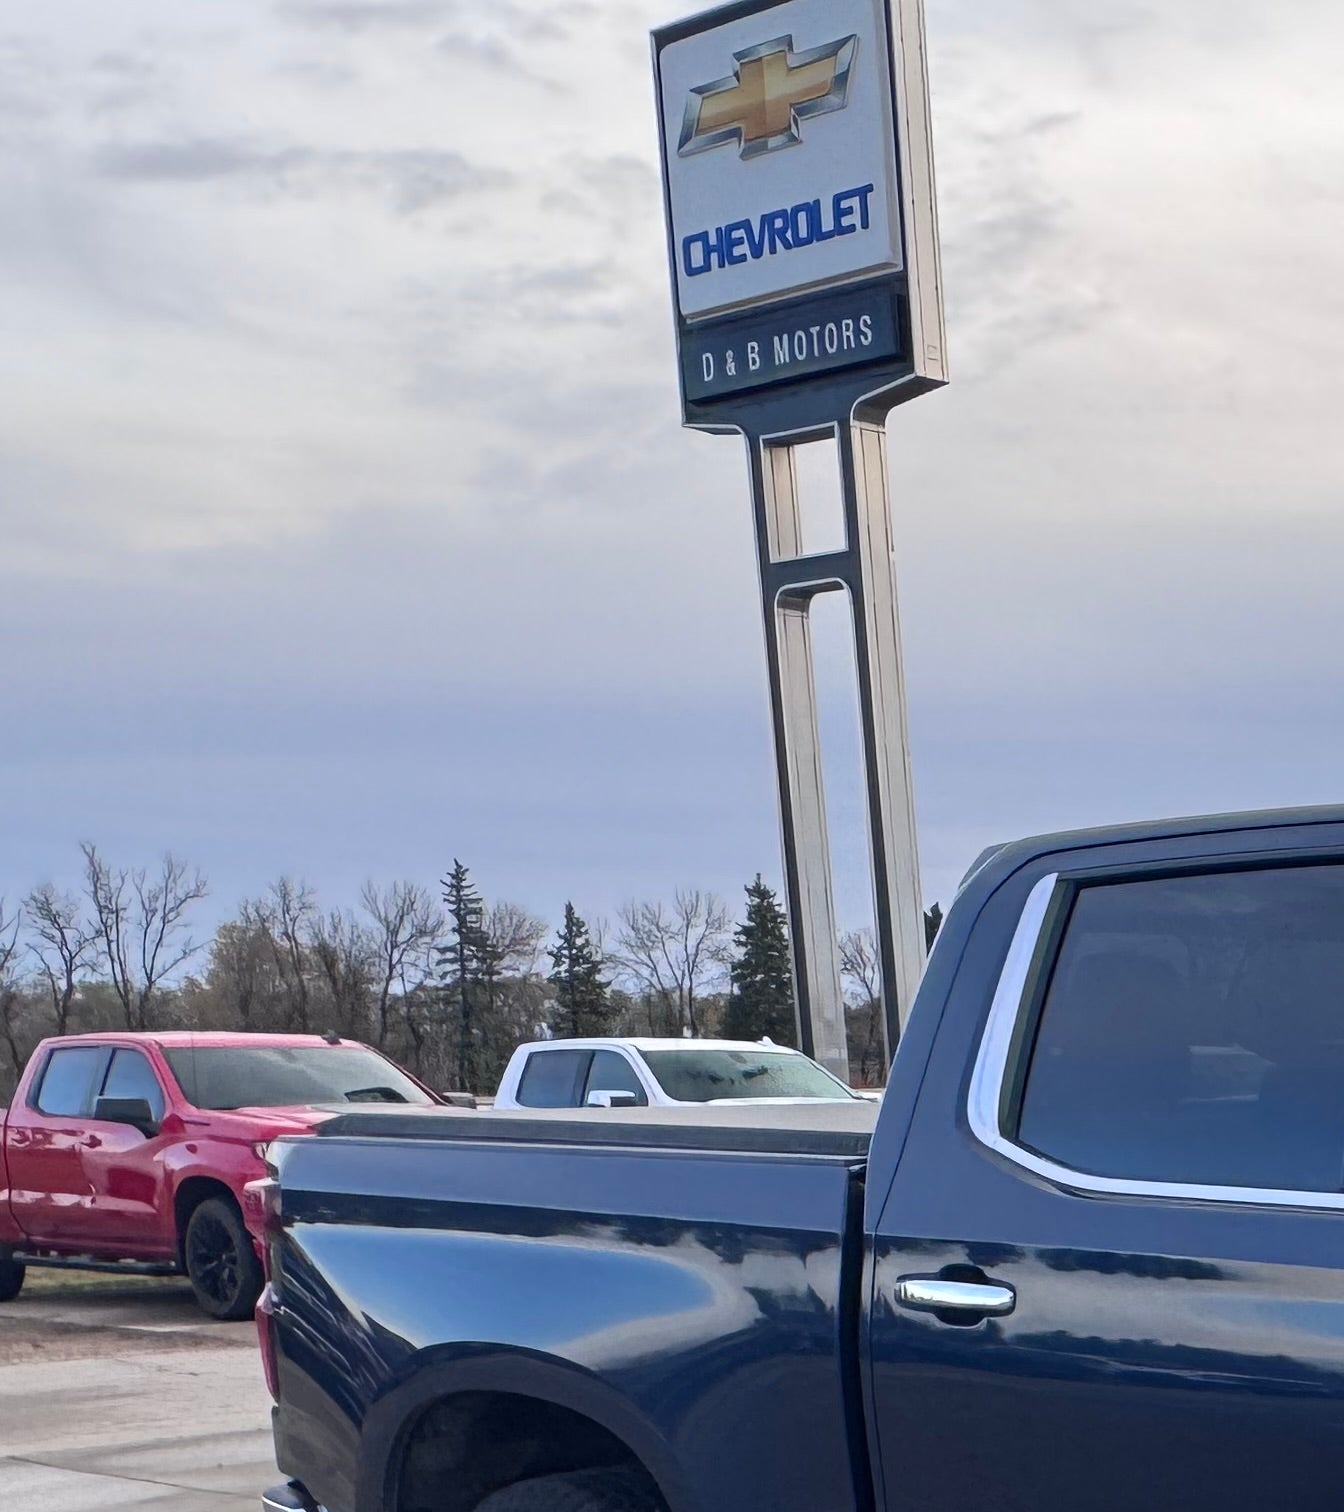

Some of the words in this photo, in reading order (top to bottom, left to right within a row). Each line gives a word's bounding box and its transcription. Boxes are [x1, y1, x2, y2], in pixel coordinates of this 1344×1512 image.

[682, 183, 873, 277] CHEVROLET
[702, 352, 714, 382] D
[726, 351, 736, 375] &
[747, 341, 760, 371] B
[774, 315, 873, 365] MOTORS
